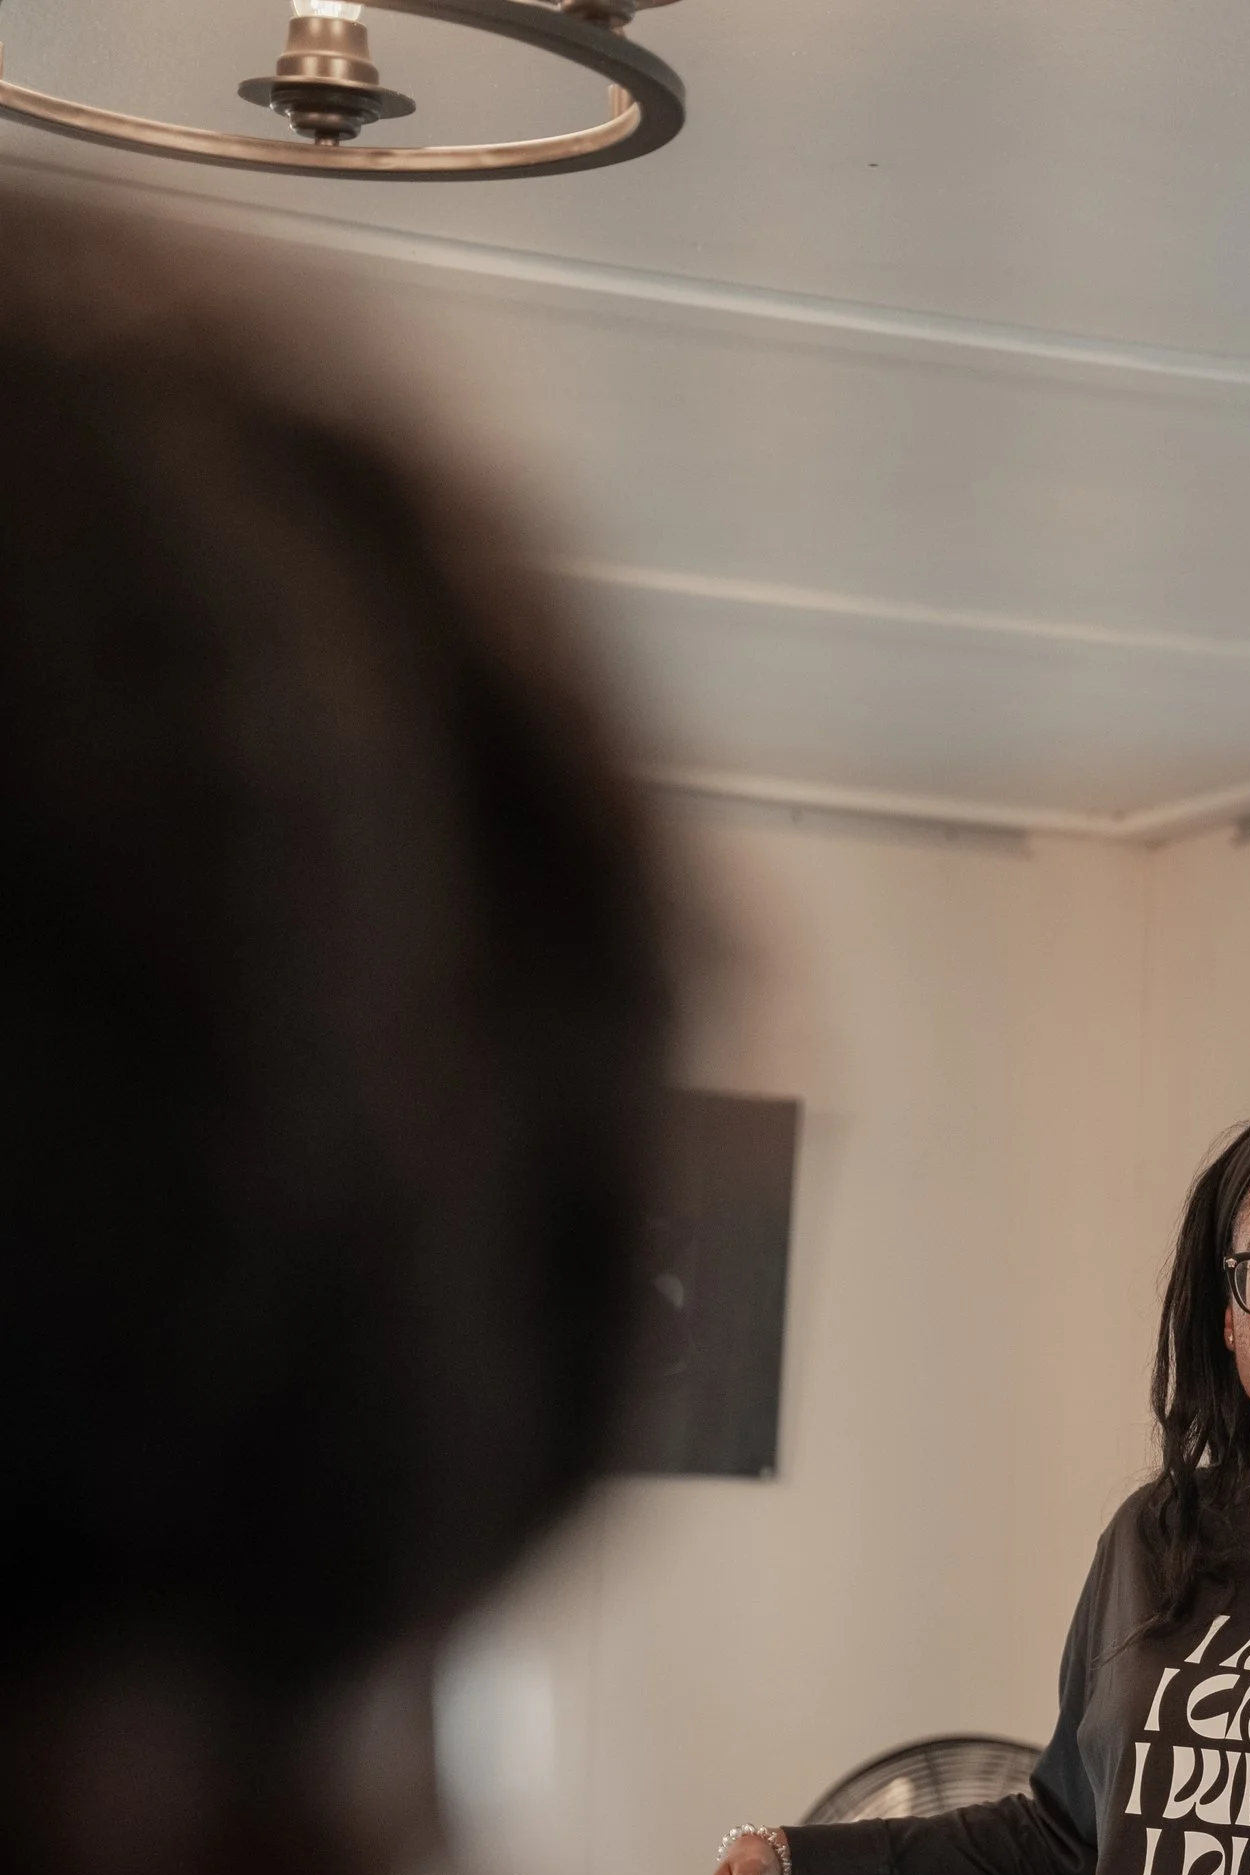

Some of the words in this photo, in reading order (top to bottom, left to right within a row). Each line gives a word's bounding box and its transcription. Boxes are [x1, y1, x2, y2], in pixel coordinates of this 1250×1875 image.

[1184, 1614, 1231, 1664] I
[1143, 1667, 1181, 1731] I
[1124, 1742, 1151, 1815] I
